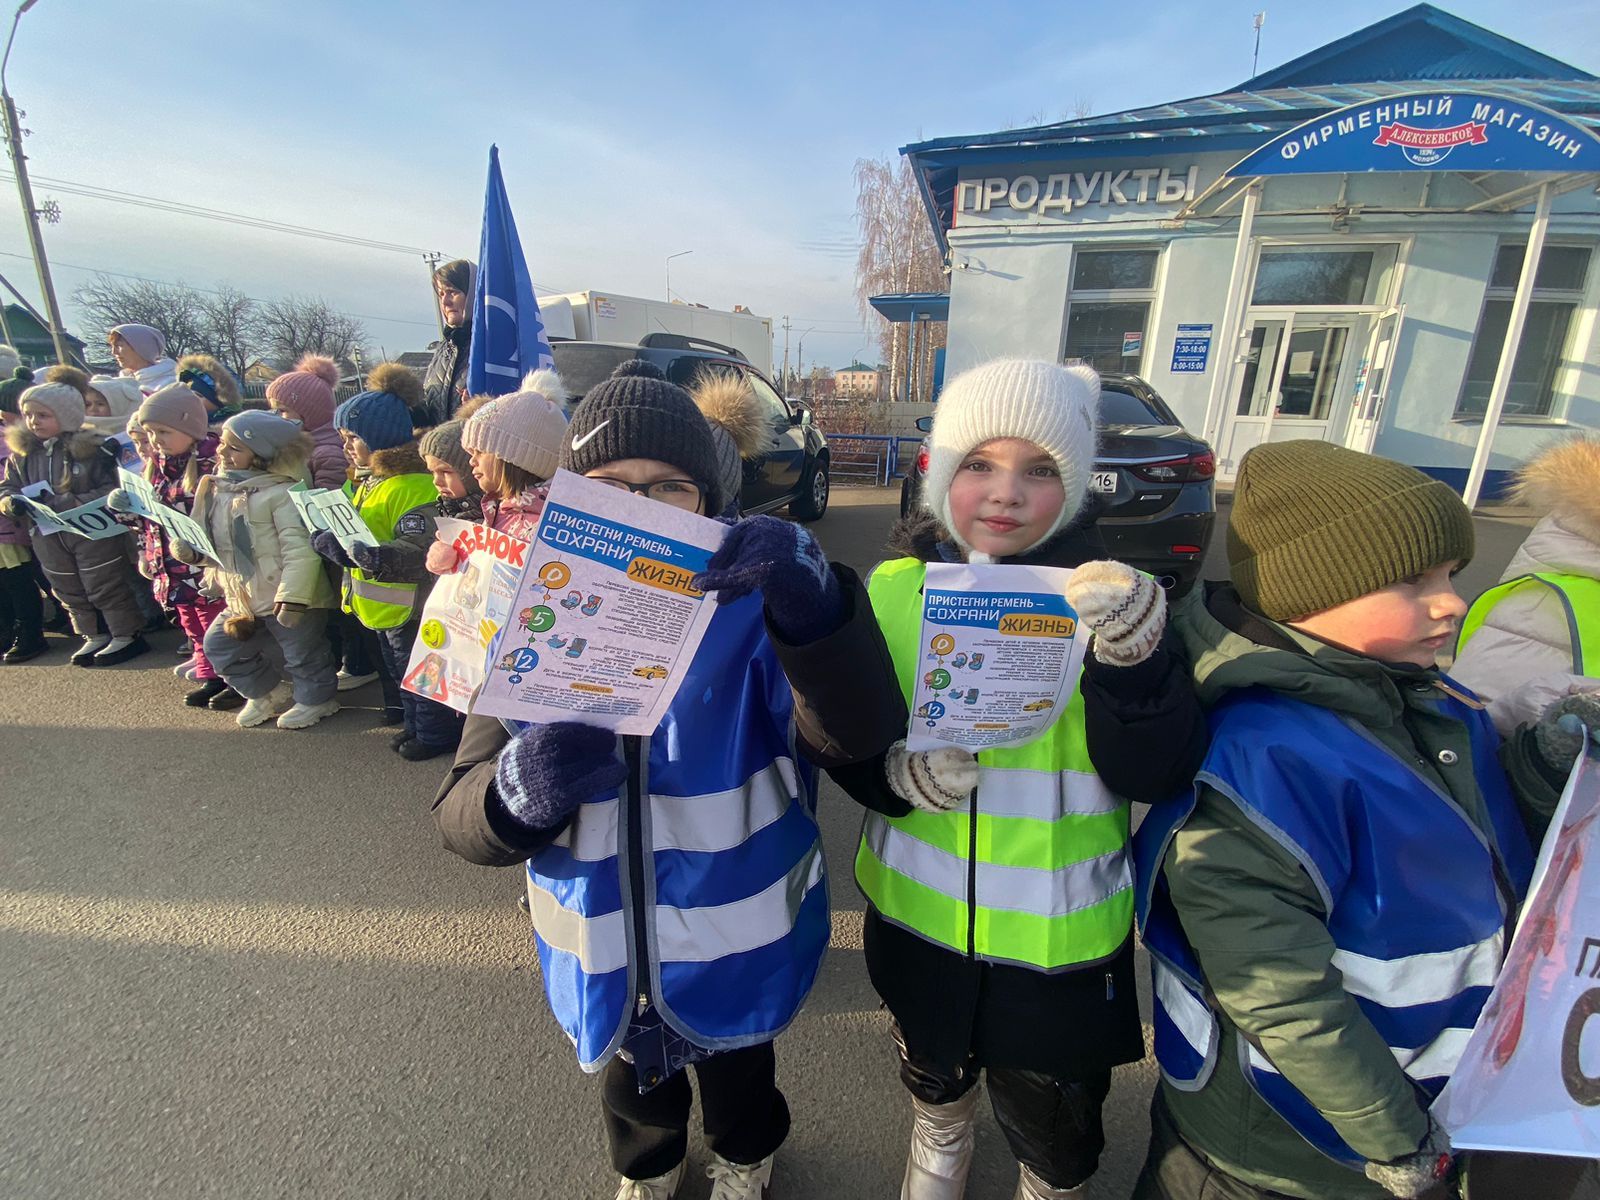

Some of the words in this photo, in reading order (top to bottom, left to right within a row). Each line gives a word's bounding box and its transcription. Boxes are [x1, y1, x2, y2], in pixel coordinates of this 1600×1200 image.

[1281, 96, 1452, 159] ФИРМЕННЫЙ
[1471, 103, 1582, 159] МАГАЗИН
[1390, 127, 1474, 145] АЛЕКСЕЕВСКОЕ
[957, 165, 1198, 214] ПРОДУКТЫ
[1095, 473, 1111, 487] 16
[548, 510, 623, 542] ПРИСТЕГНИ
[626, 533, 673, 558] РЕМЕНЬ
[541, 525, 633, 562] СОХРАНИ
[928, 594, 988, 607] ПРИСТЕГНИ
[990, 598, 1034, 608] РЕМЕНЬ
[531, 611, 551, 626] 5
[926, 607, 1000, 621] СОХРАНИ
[1001, 618, 1074, 635] ЖИЗНЬ!
[514, 650, 533, 669] 12
[933, 673, 946, 686] 5
[927, 703, 942, 718] 12
